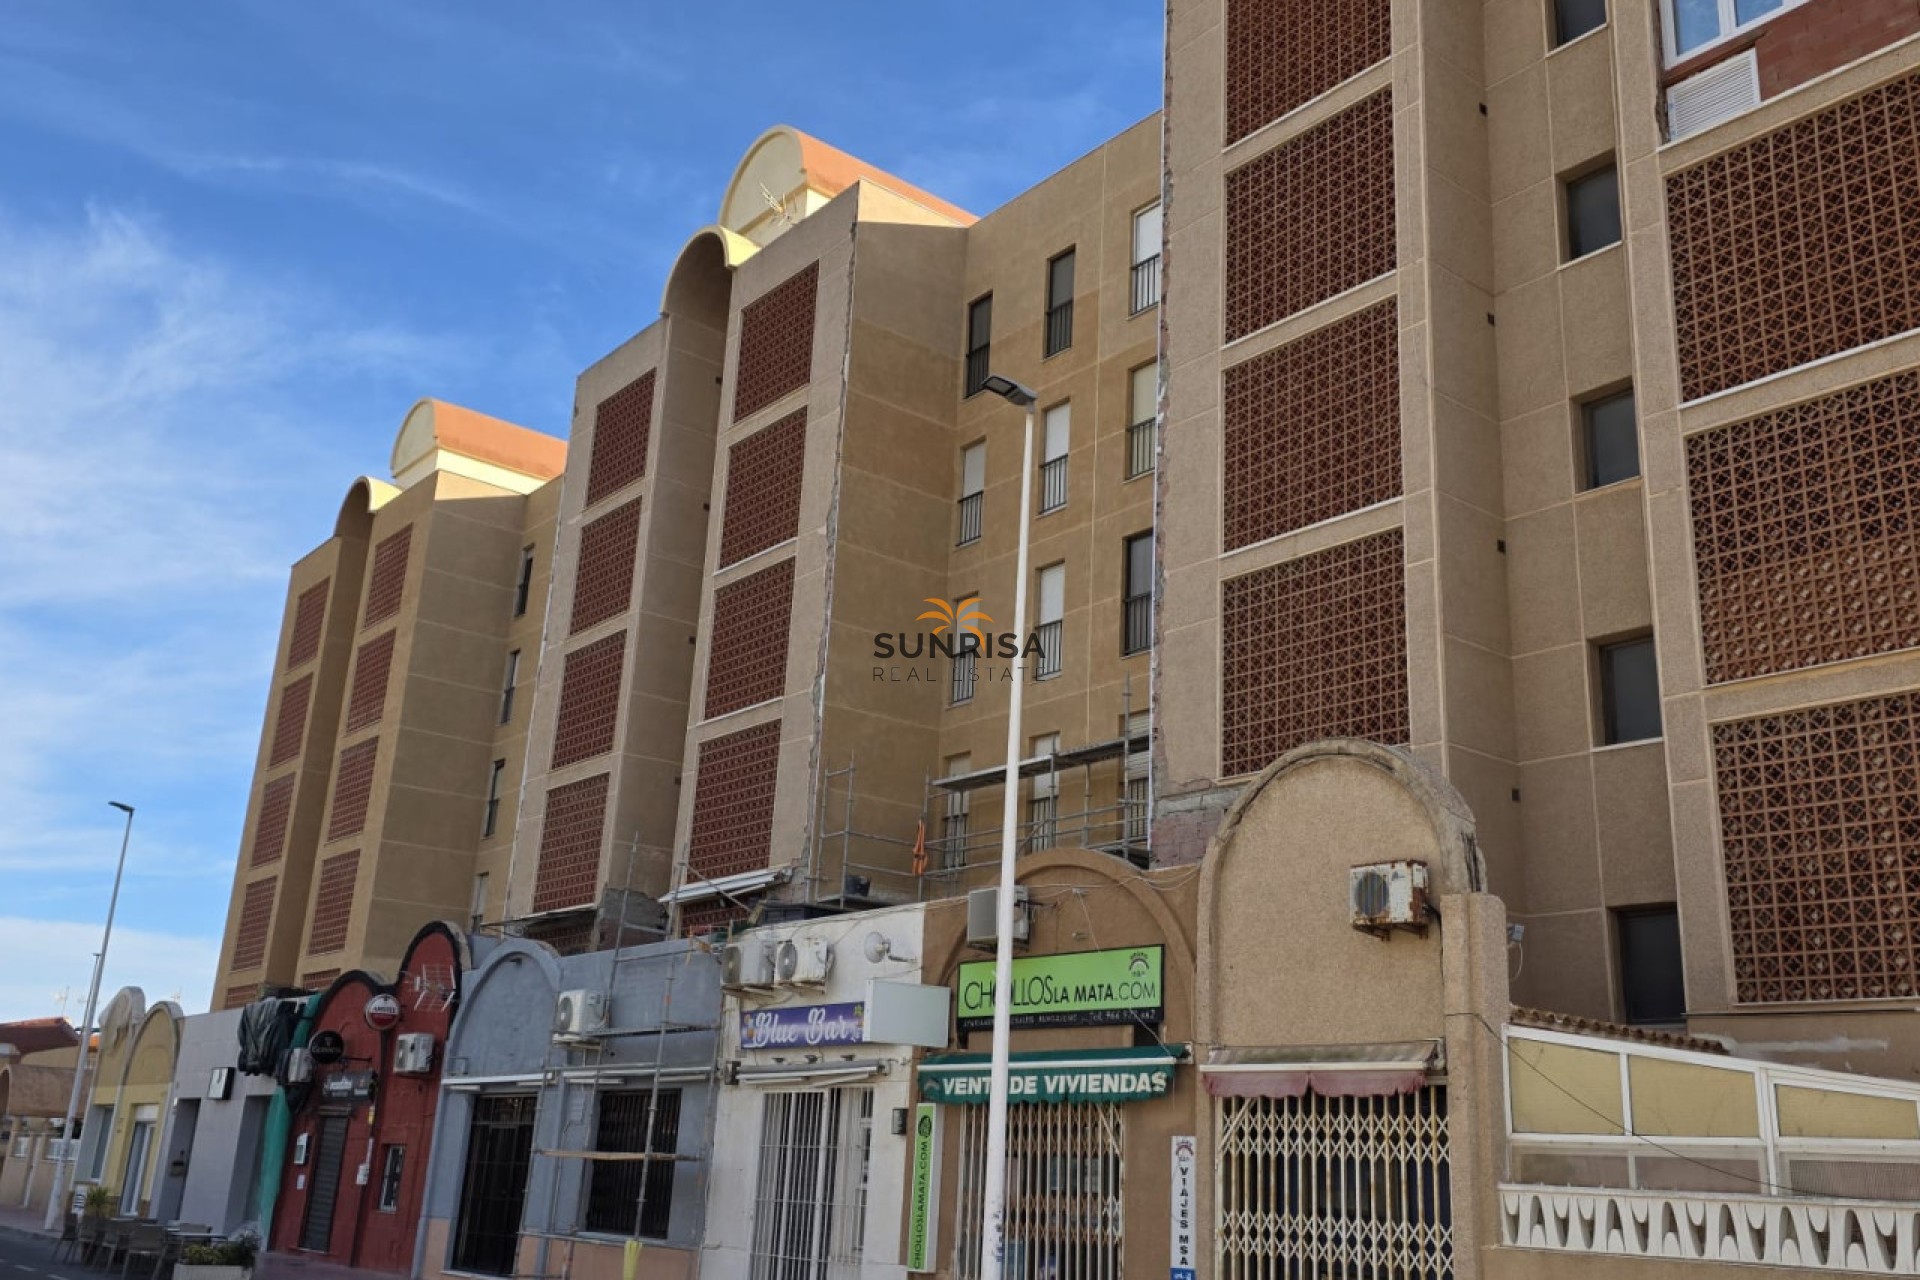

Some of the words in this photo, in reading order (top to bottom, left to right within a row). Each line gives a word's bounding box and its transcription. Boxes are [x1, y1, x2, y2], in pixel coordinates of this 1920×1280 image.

[964, 975, 1053, 1010] CHLLOS
[743, 1012, 799, 1049] Blue
[943, 1076, 993, 1095] VENT
[1009, 1075, 1038, 1095] DE
[1044, 1071, 1168, 1094] VIVIENDAS
[1179, 1167, 1189, 1230] VIAJES
[1179, 1234, 1189, 1266] MSA
